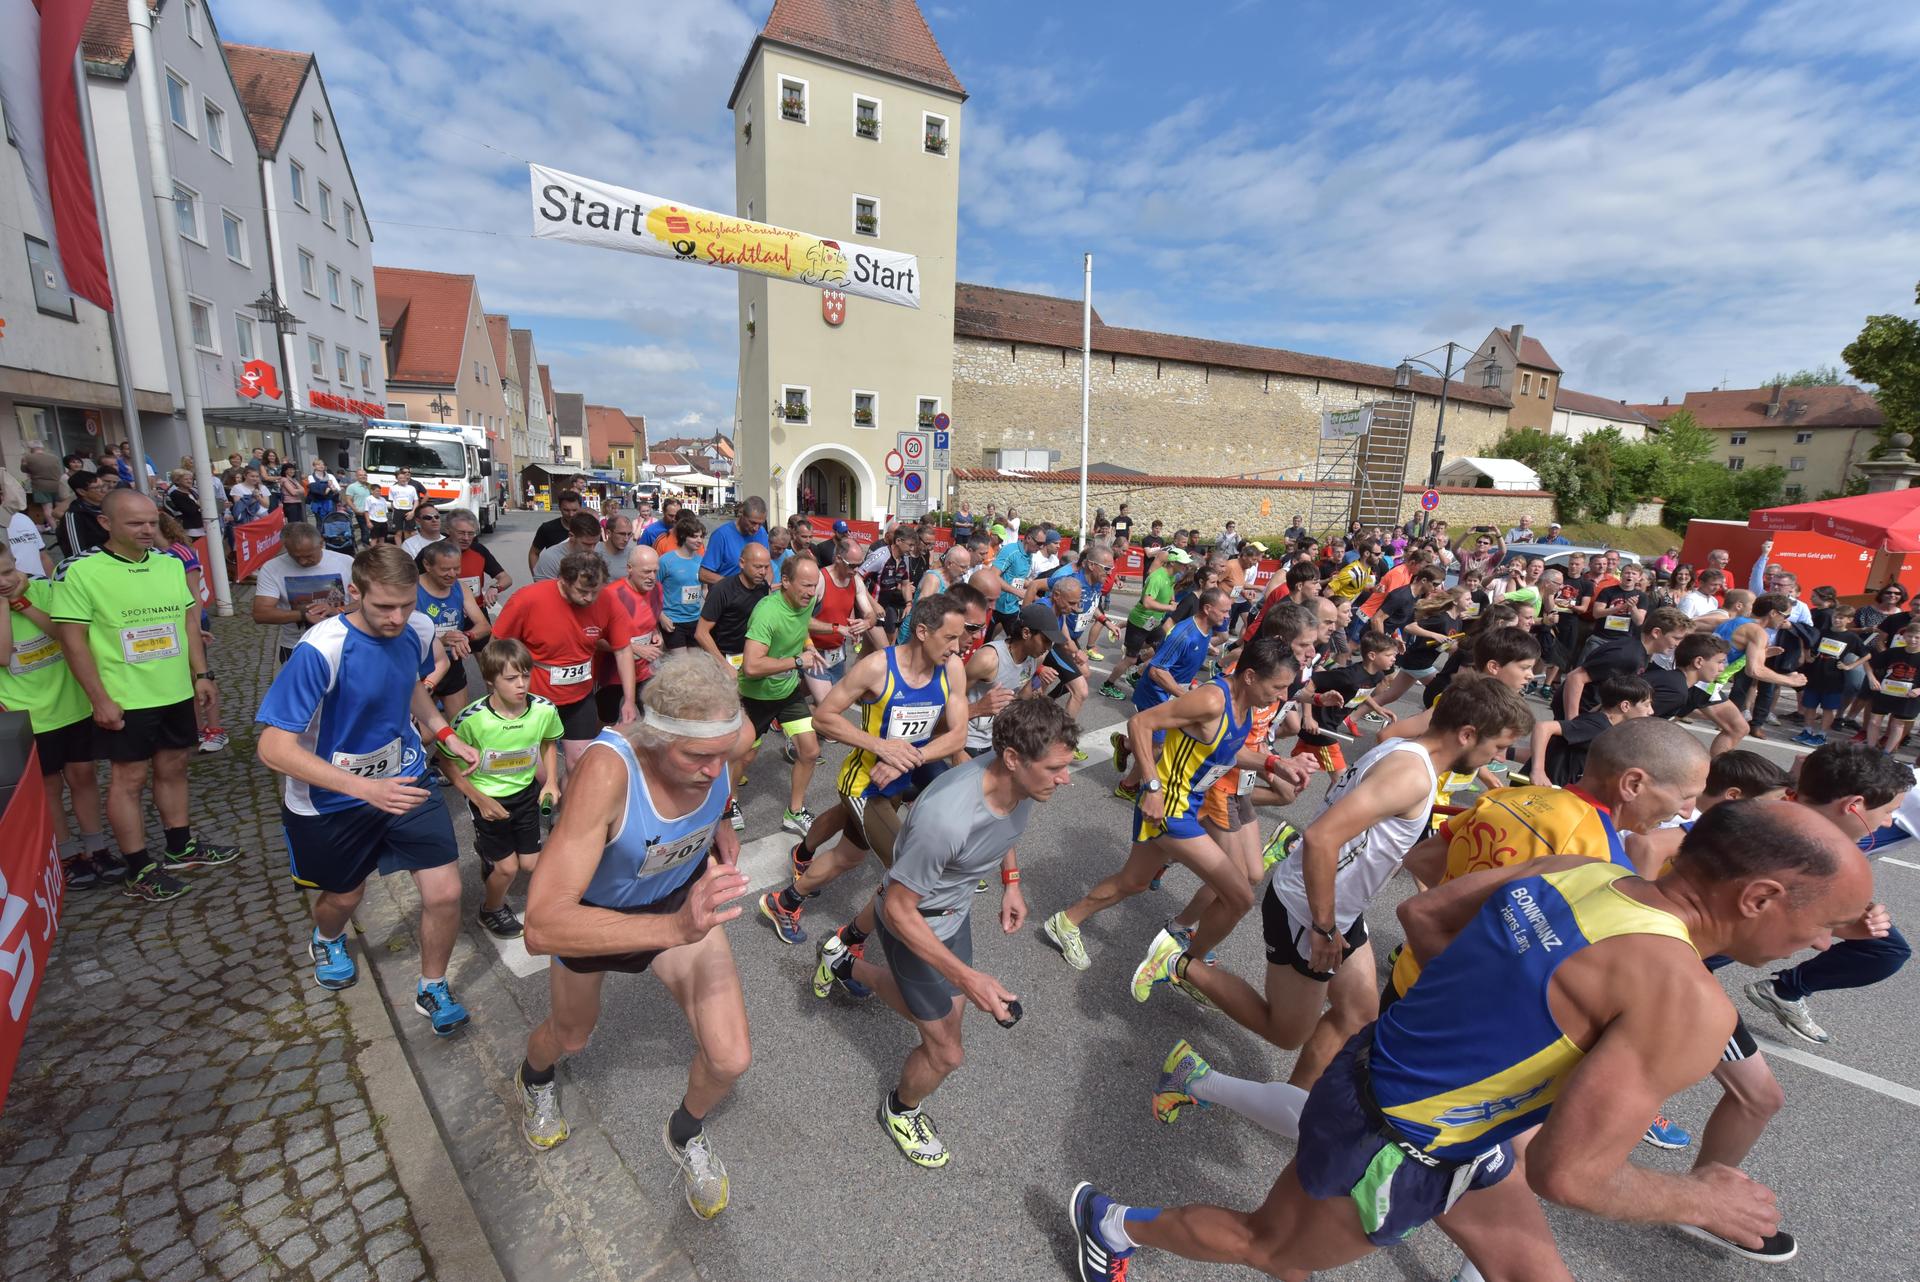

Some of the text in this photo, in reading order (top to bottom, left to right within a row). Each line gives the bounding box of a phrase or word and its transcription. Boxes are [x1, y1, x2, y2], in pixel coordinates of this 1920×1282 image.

[540, 184, 644, 236] Start
[706, 242, 792, 272] Stadtlauf
[854, 253, 914, 294] Start
[908, 442, 919, 453] 20
[562, 665, 584, 679] 734
[901, 720, 928, 736] 727
[1500, 904, 1531, 954] Hans Lang
